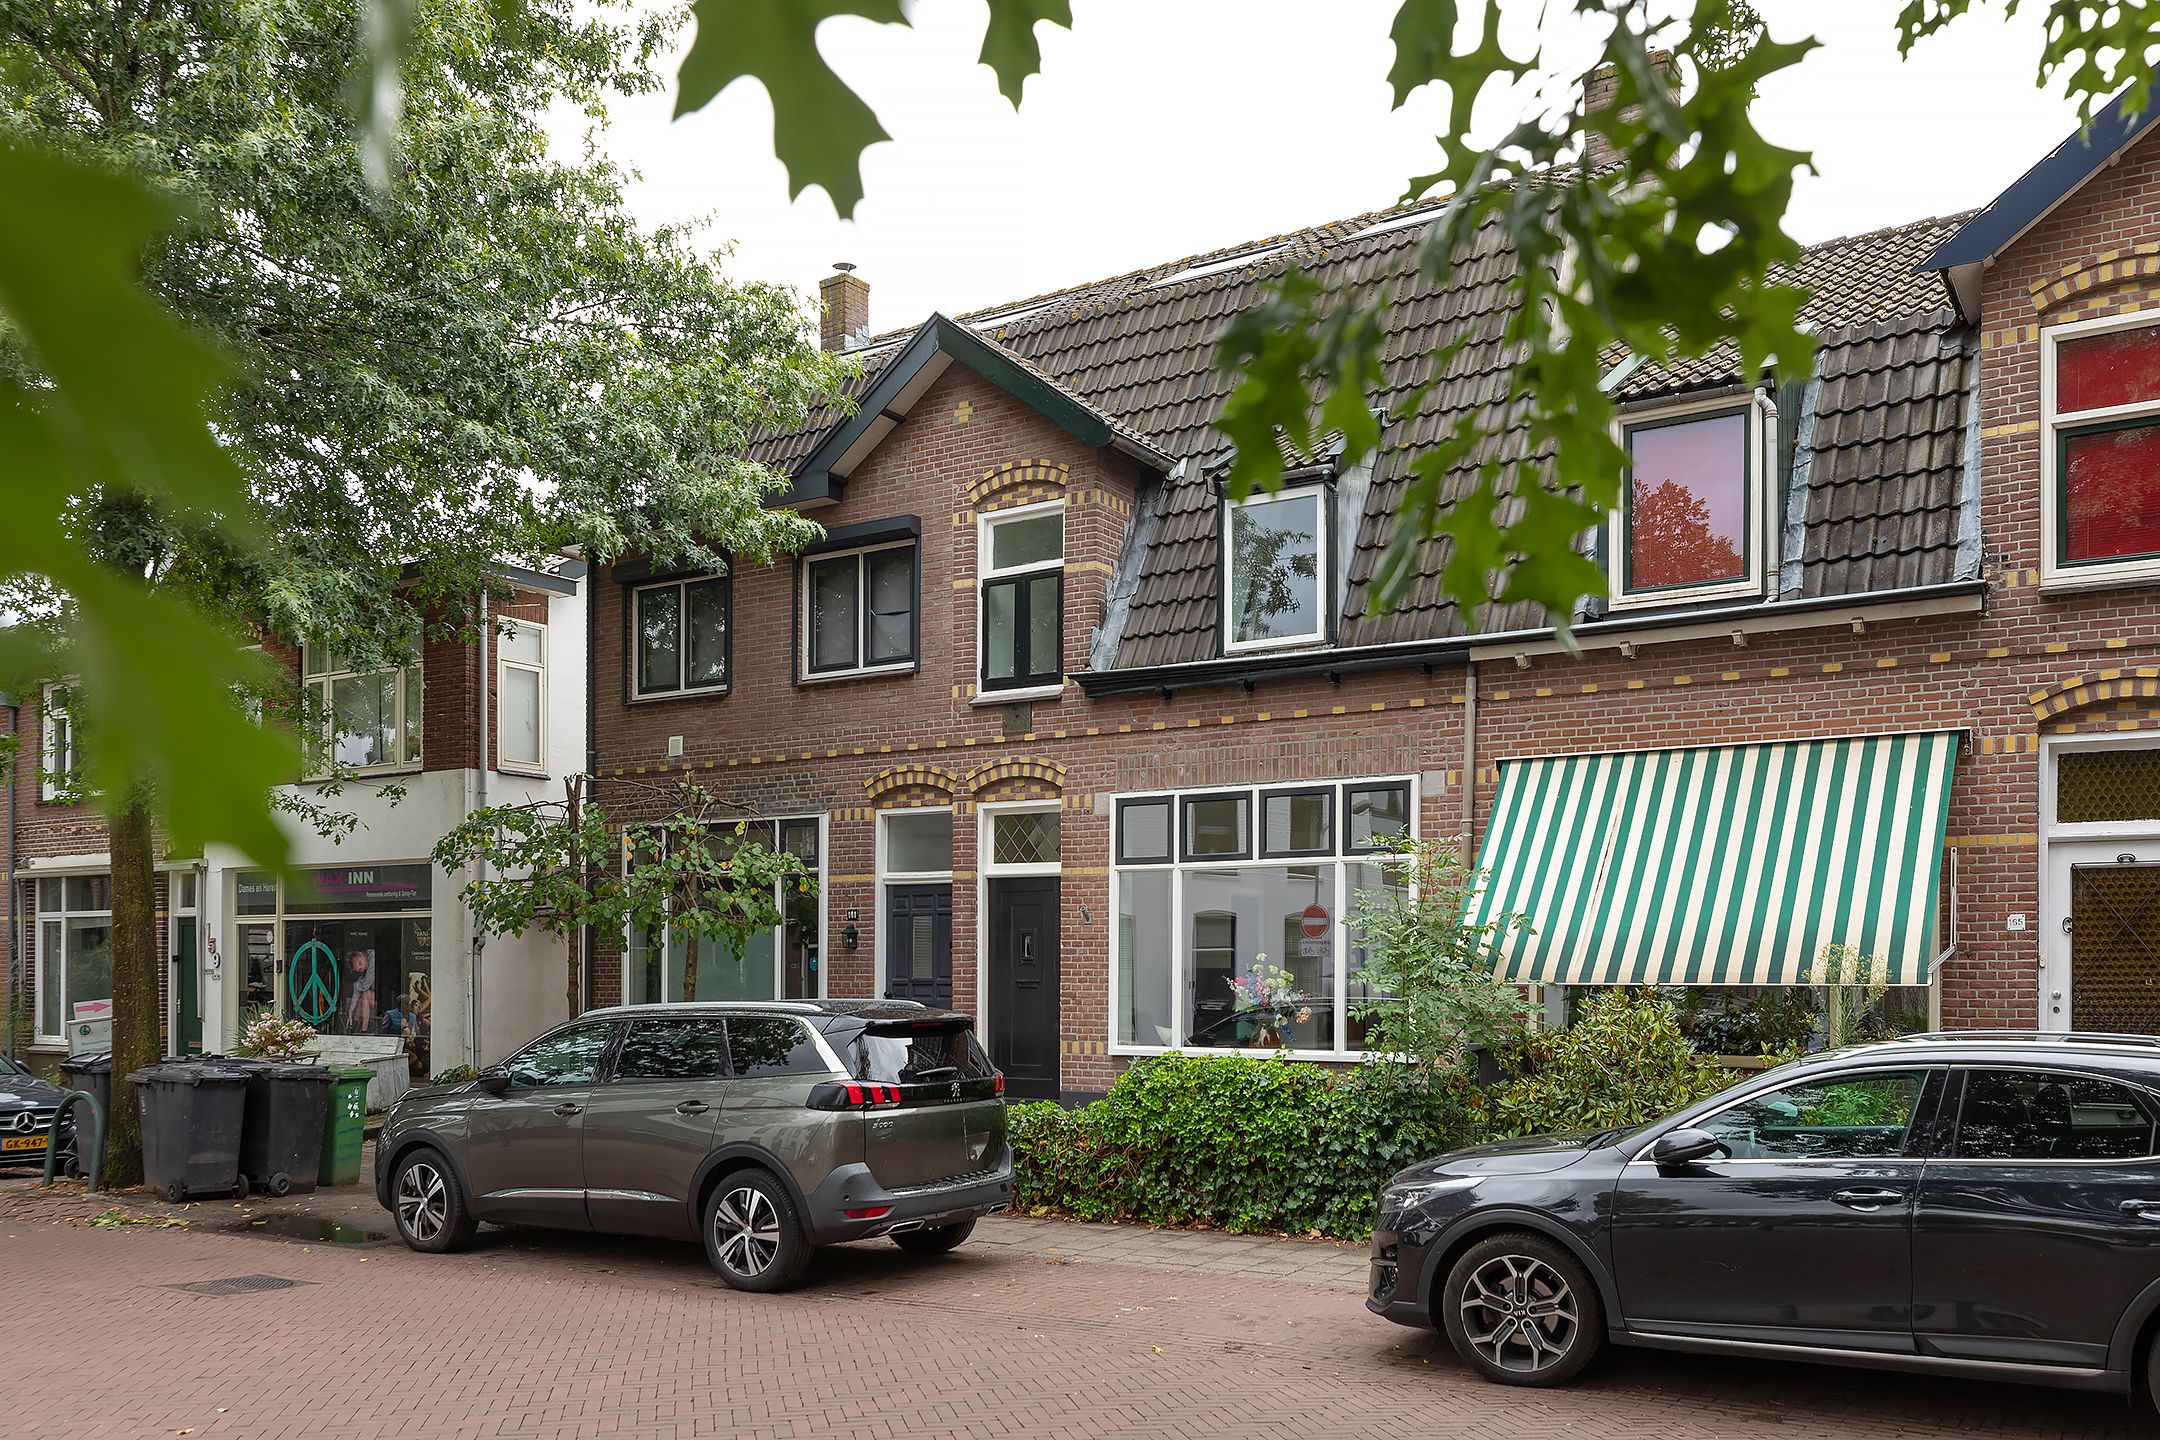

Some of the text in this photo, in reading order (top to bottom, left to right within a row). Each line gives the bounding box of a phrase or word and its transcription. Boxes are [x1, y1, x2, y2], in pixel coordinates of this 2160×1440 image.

[238, 883, 255, 893] Dames
[256, 884, 262, 892] en
[2009, 918, 2024, 926] 165
[5, 1137, 48, 1149] GK-947-
